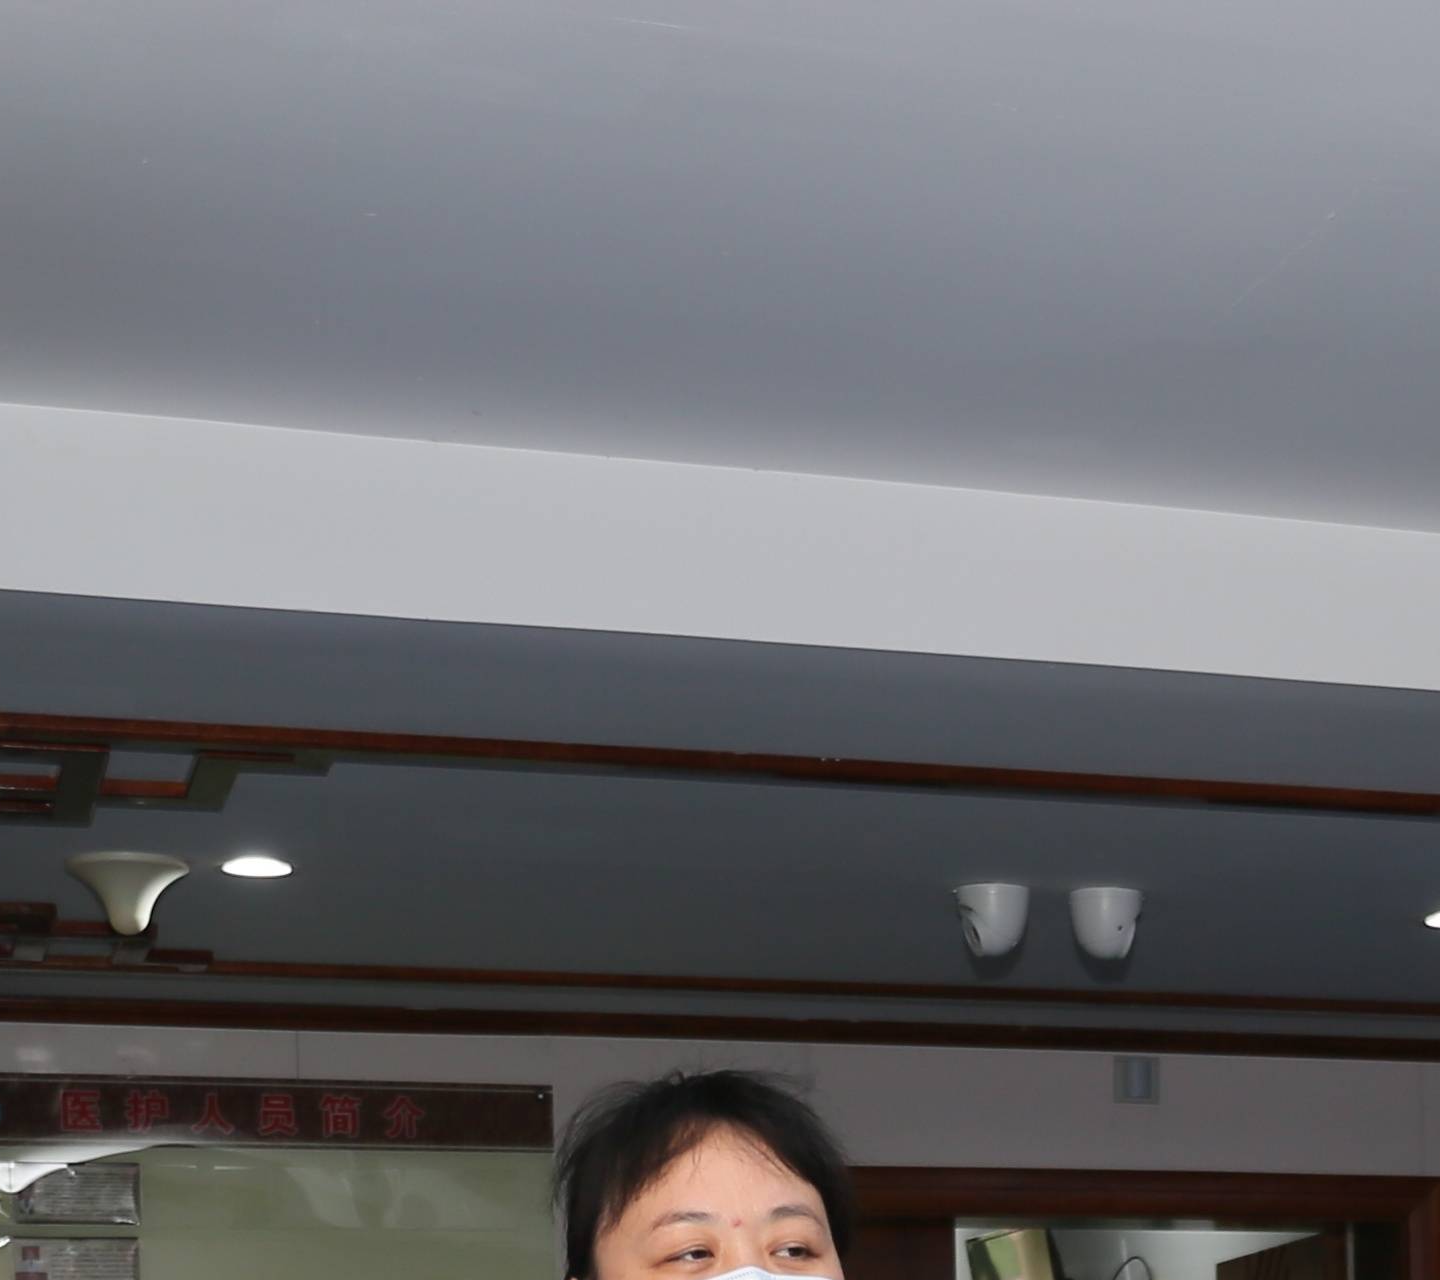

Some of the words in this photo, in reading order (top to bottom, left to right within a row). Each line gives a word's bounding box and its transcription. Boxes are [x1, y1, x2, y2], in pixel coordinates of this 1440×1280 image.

[61, 1088, 426, 1138] 医护人员简介
